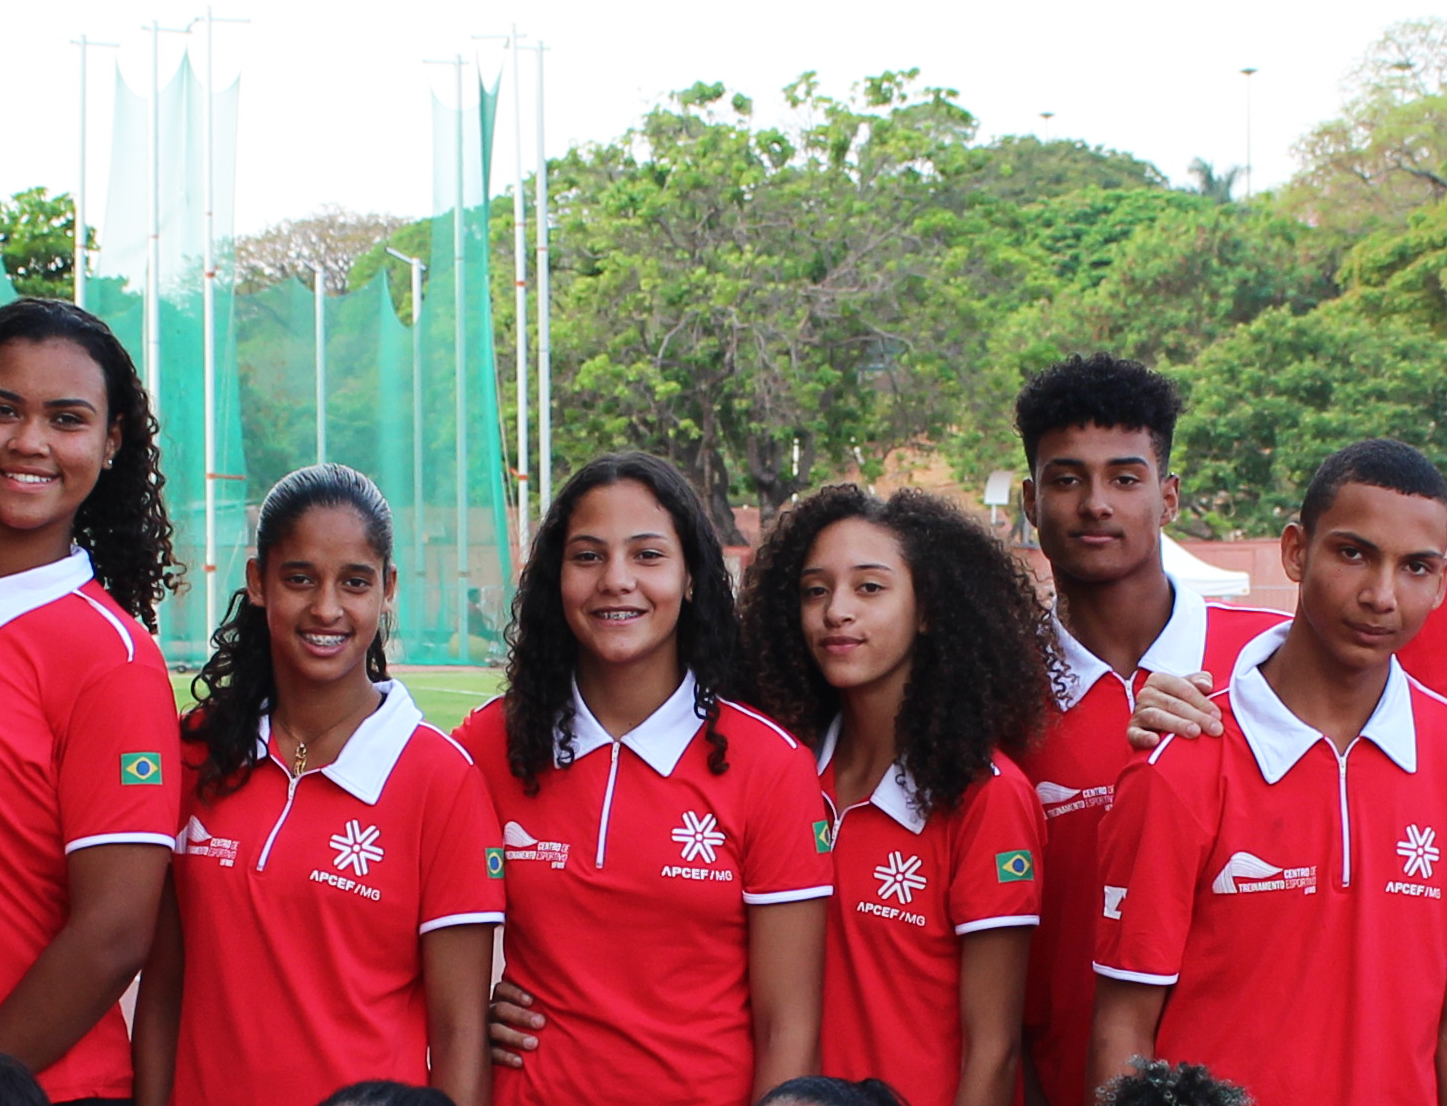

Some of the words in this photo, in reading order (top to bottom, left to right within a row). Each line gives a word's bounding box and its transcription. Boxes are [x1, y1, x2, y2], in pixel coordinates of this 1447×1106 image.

[661, 865, 733, 882] APCEF/MG
[309, 869, 381, 901] APCEF/MG
[1385, 881, 1442, 899] APCEF/MG
[857, 901, 926, 927] APCEF/MG
